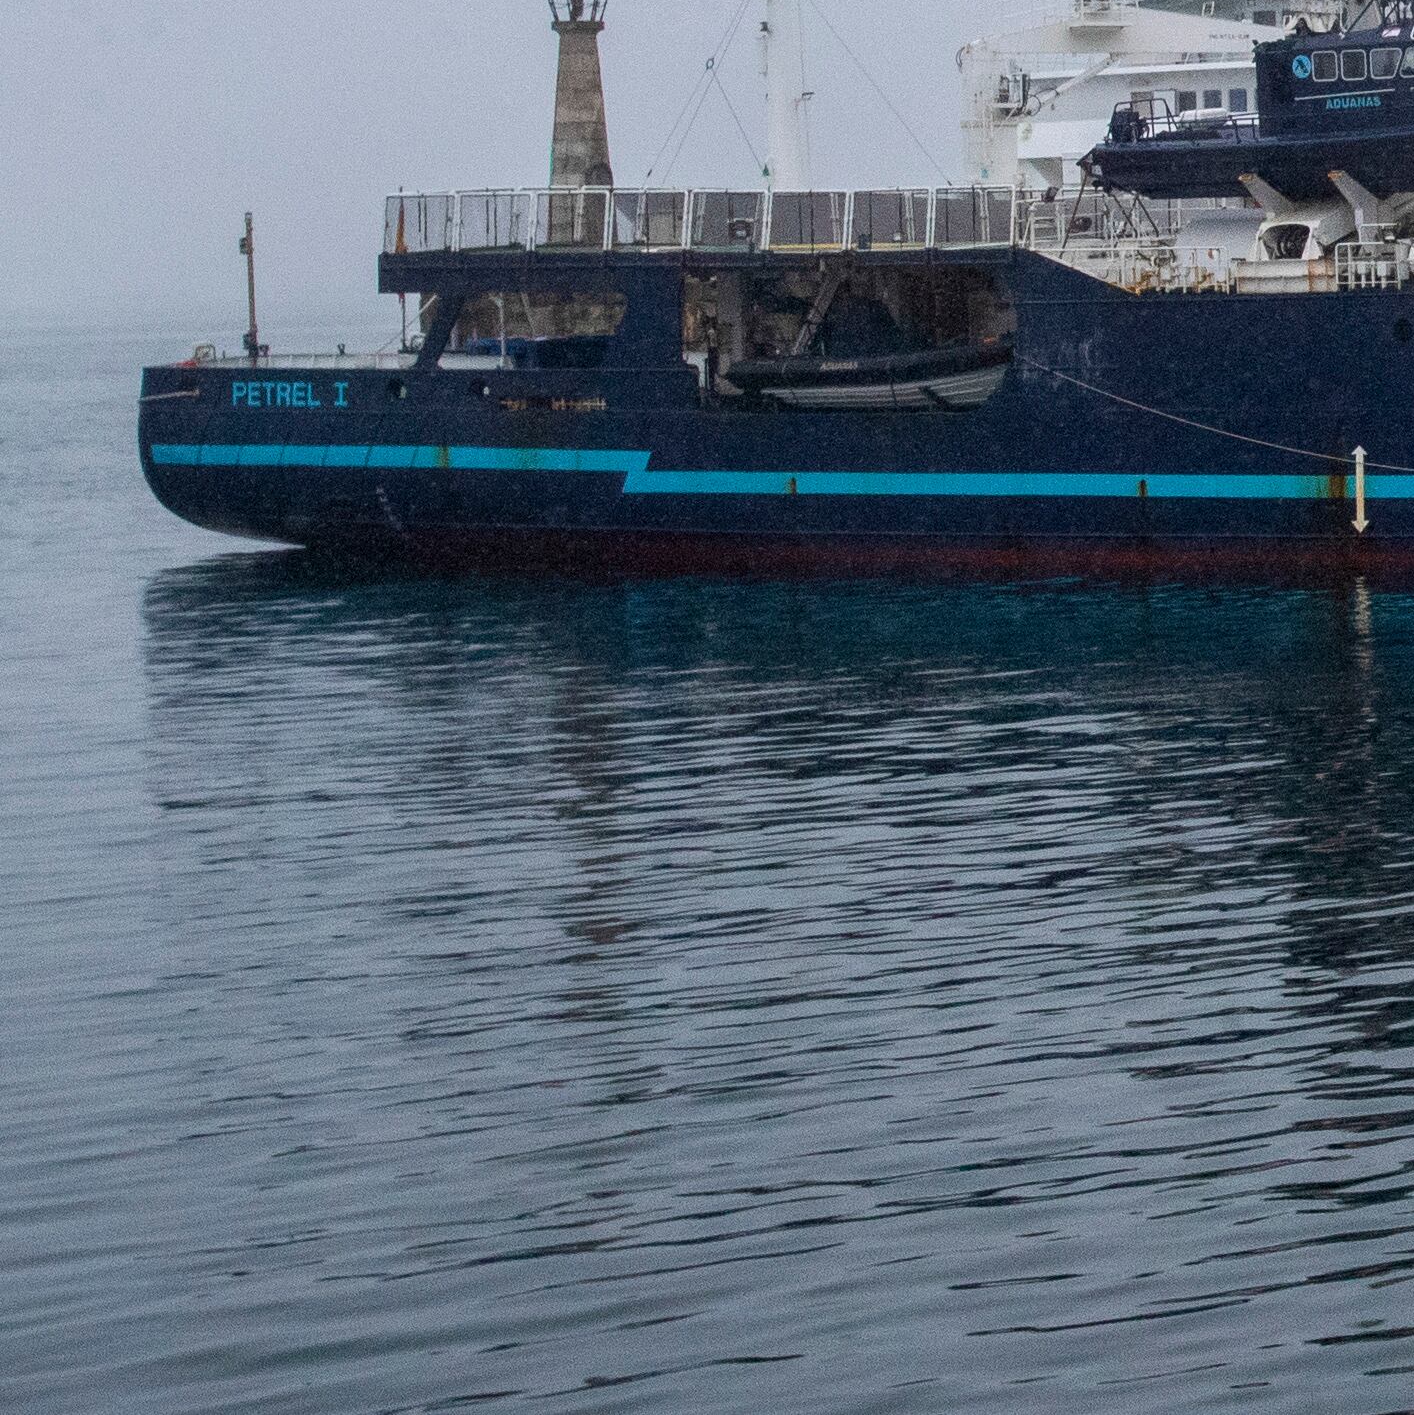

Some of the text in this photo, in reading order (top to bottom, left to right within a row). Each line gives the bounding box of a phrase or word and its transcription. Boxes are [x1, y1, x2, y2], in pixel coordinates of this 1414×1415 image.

[1326, 96, 1382, 109] ADUANAS
[232, 381, 348, 407] PETREL I
